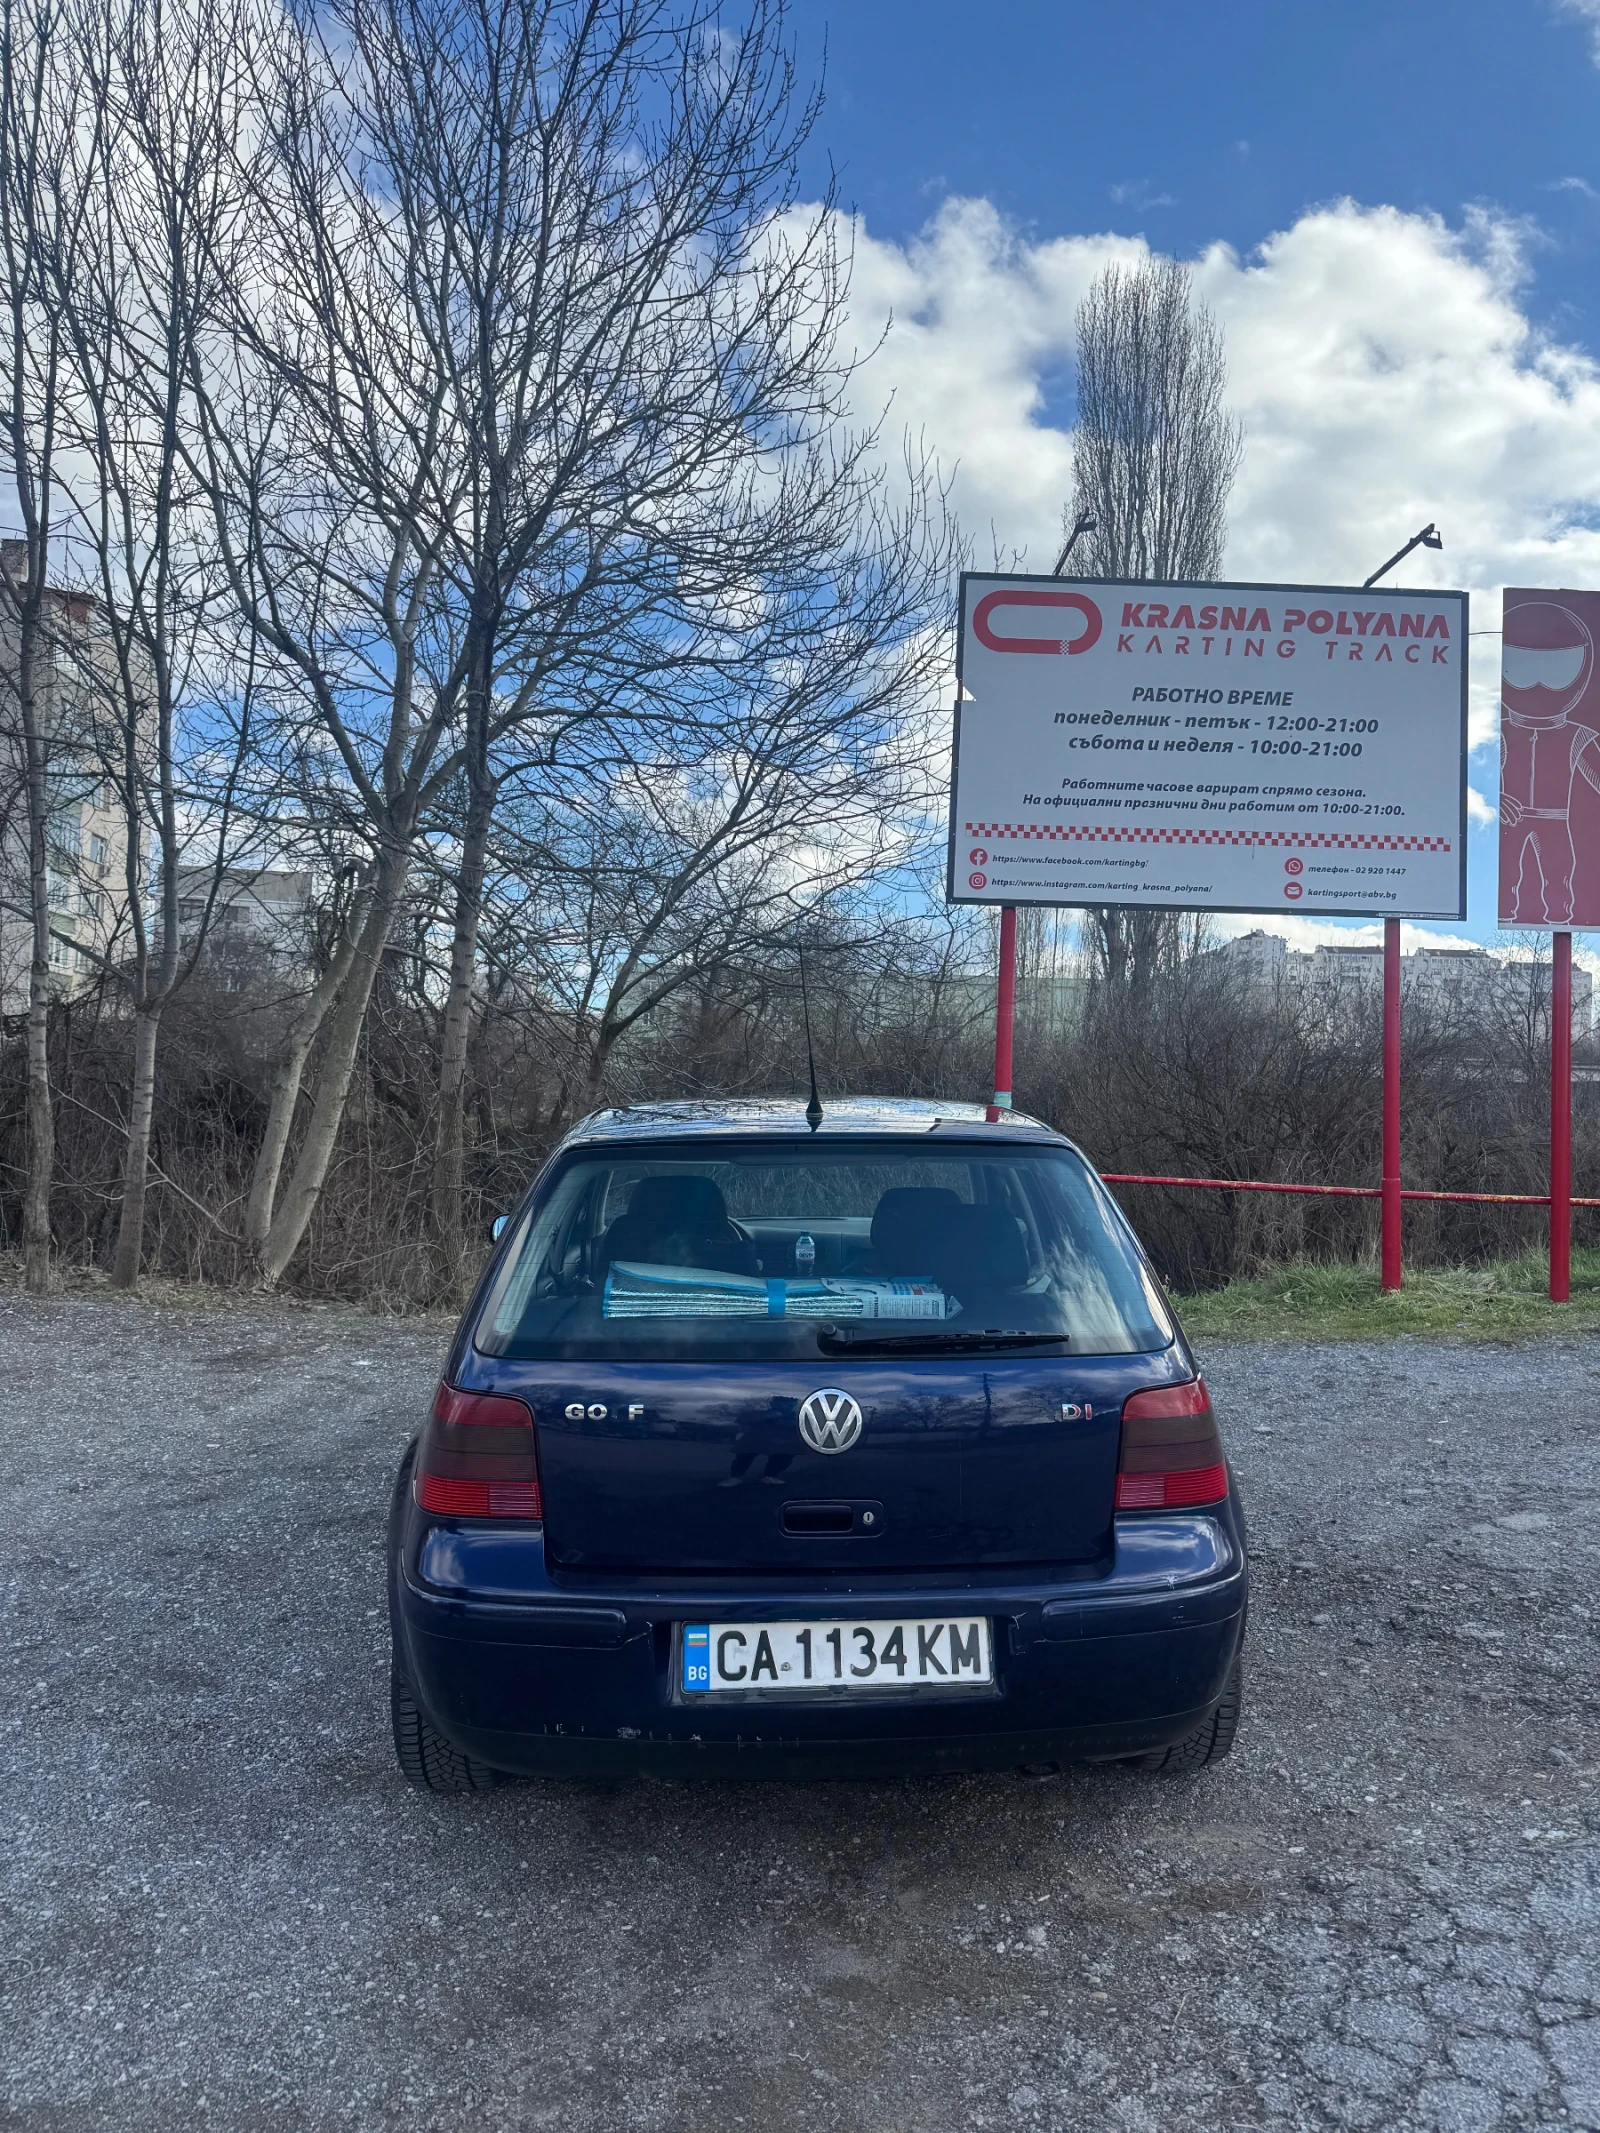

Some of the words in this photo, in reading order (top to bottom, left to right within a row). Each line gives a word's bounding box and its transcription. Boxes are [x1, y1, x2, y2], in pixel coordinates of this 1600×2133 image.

[1121, 603, 1272, 632] KRASNA
[1283, 609, 1450, 638] POLYANA
[1117, 634, 1296, 658] KARTING
[1325, 641, 1449, 664] TRACK
[1131, 687, 1223, 704] РАБОТНО
[1227, 690, 1294, 706] ВРЕМЕ
[1053, 710, 1171, 727] понеделник
[1184, 716, 1251, 729] петък
[1267, 716, 1379, 733] 12:00-21:00
[1068, 734, 1145, 751] събота
[1147, 739, 1160, 751] и
[1163, 737, 1234, 753] неделя
[1250, 740, 1363, 757] 10:00-21:00
[1061, 778, 1145, 791] Работните
[1146, 782, 1194, 793] часове
[1196, 784, 1259, 796] варират
[1262, 787, 1313, 798] спрямо
[1316, 787, 1367, 798] сезона.
[1022, 794, 1041, 805] На
[1043, 795, 1122, 808] официални
[1124, 799, 1198, 811] празнични
[1201, 799, 1226, 810] дни
[1228, 800, 1295, 813] работим
[1298, 804, 1319, 813] от
[1323, 803, 1405, 816] 10:00-21:00.
[1308, 866, 1349, 874] телефон
[991, 879, 1213, 893] https://www.instagram.com/karting_krasna_polyana/
[1308, 888, 1397, 900] kartingsport@abv.bg
[688, 1666, 708, 1681] BG
